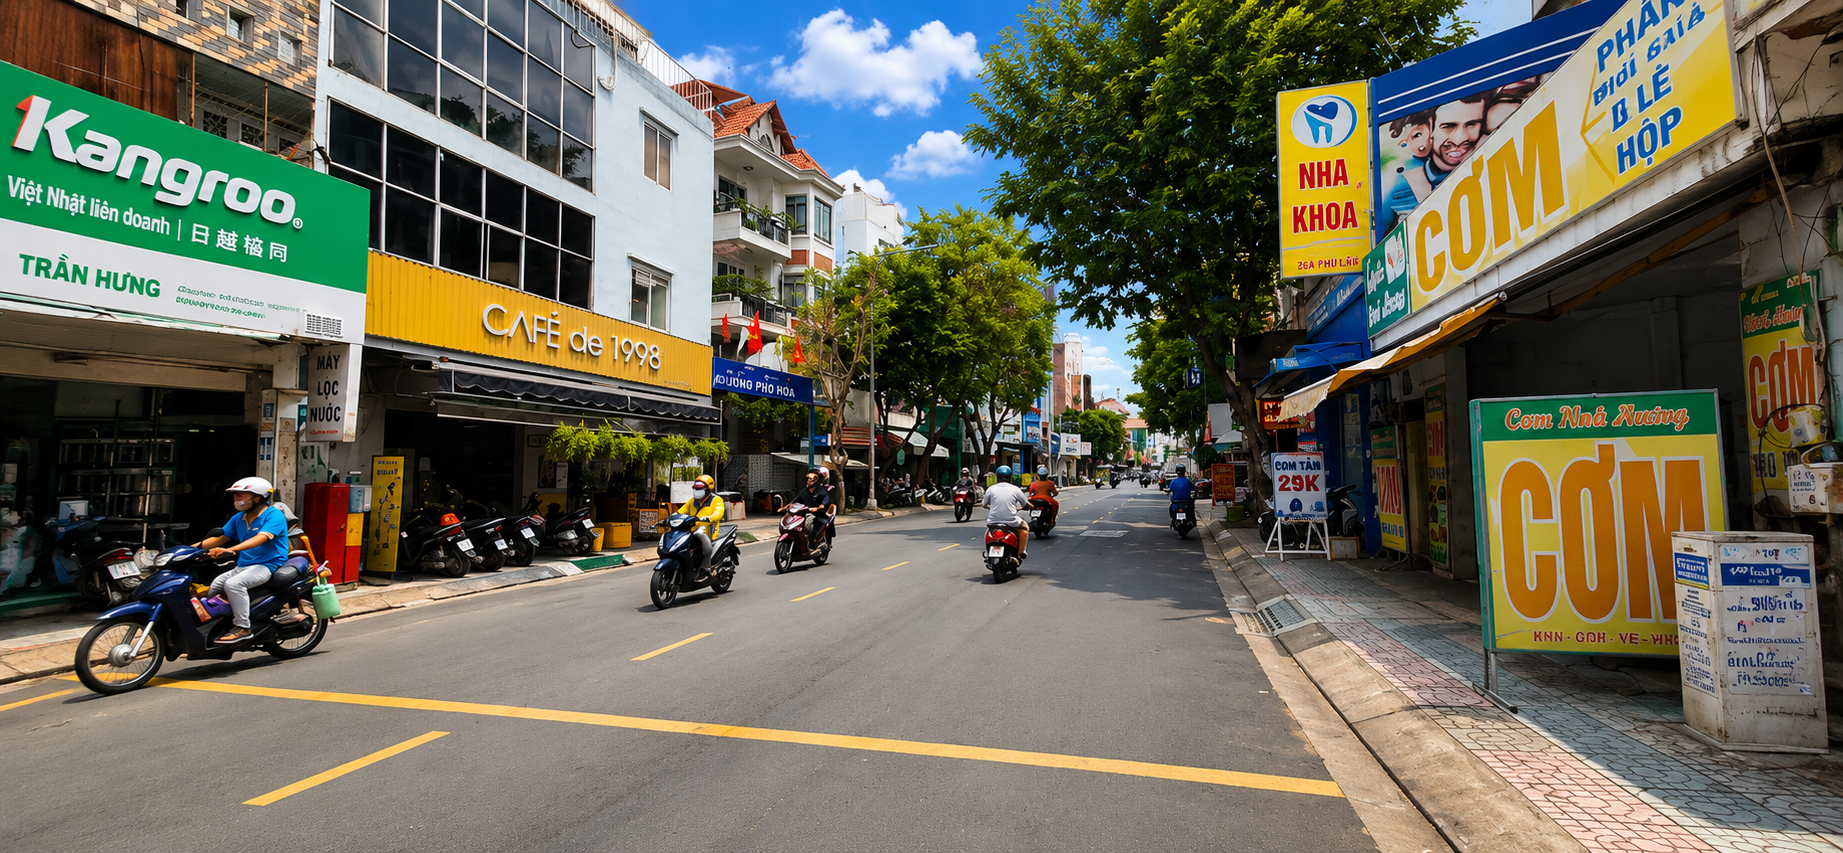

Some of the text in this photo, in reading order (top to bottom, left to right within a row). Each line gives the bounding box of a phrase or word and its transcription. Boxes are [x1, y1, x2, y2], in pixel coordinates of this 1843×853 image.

[11, 94, 296, 224] Kangroo
[1616, 106, 1682, 175] HỘP
[1298, 158, 1349, 191] NHA
[1414, 98, 1566, 293] CƠM
[8, 175, 170, 235] Việt Nhật liên doanh
[1292, 201, 1359, 234] KHOA
[19, 253, 161, 298] TRẦN HƯNG
[316, 351, 341, 371] MÁY
[482, 303, 662, 371] CAFÉ de 1998
[317, 379, 339, 400] LỌC
[1748, 338, 1818, 434] CƠM
[1278, 474, 1320, 492] 29K
[1498, 441, 1711, 624] CƠM
